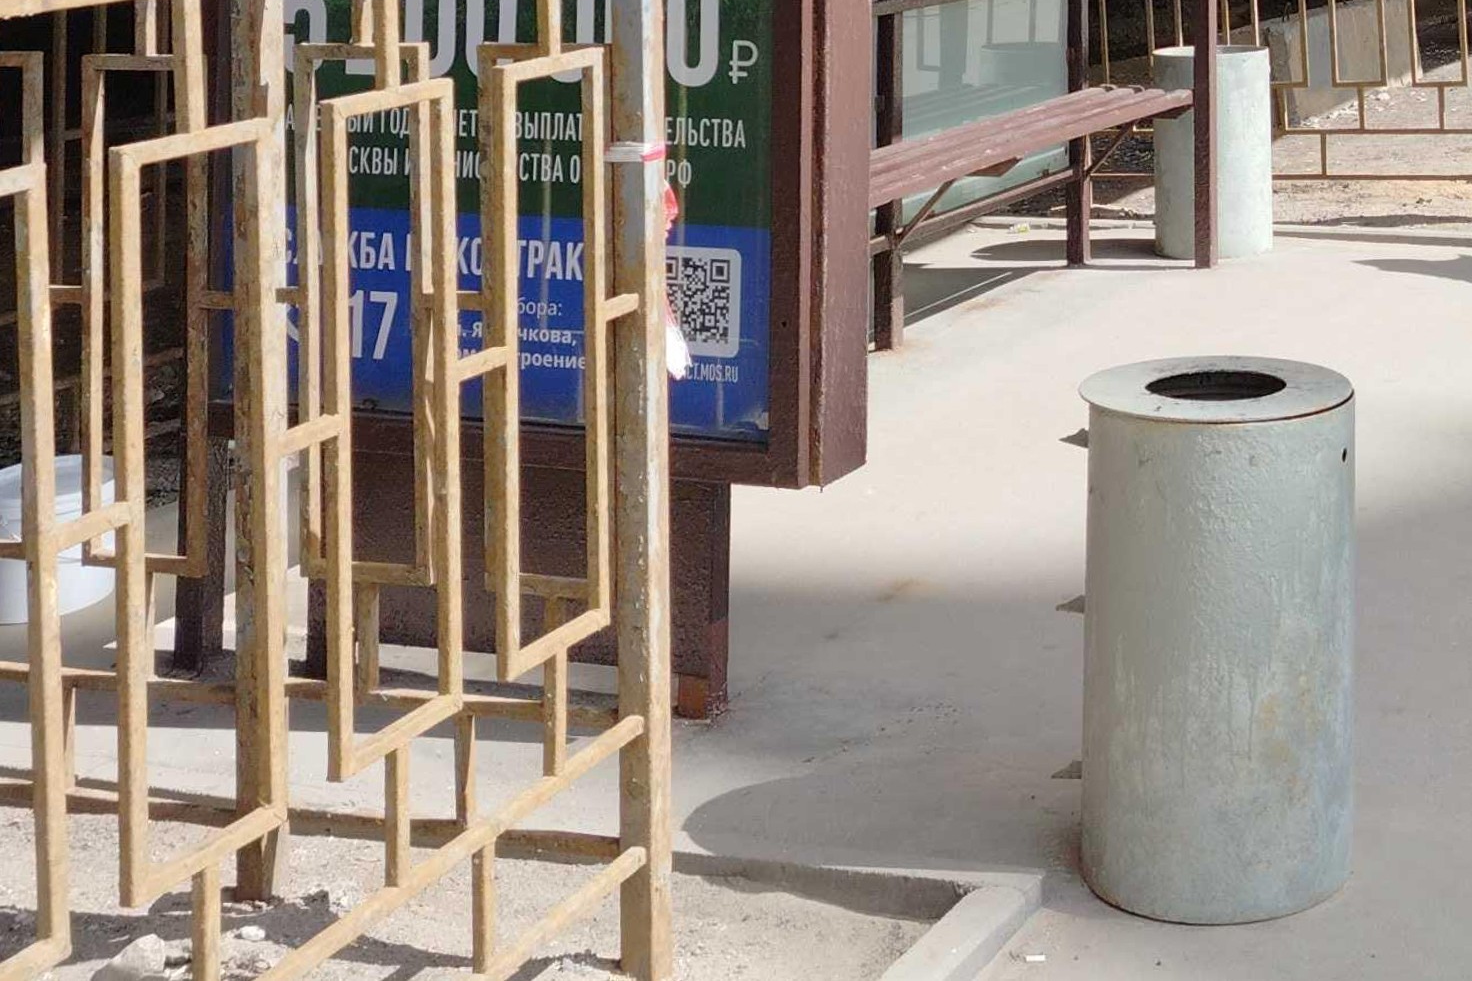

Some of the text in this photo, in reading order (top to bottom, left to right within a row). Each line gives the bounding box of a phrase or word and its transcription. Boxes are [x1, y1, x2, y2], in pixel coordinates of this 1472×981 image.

[349, 146, 398, 176] СКВЫ
[518, 297, 563, 319] бора:
[349, 289, 398, 360] 17
